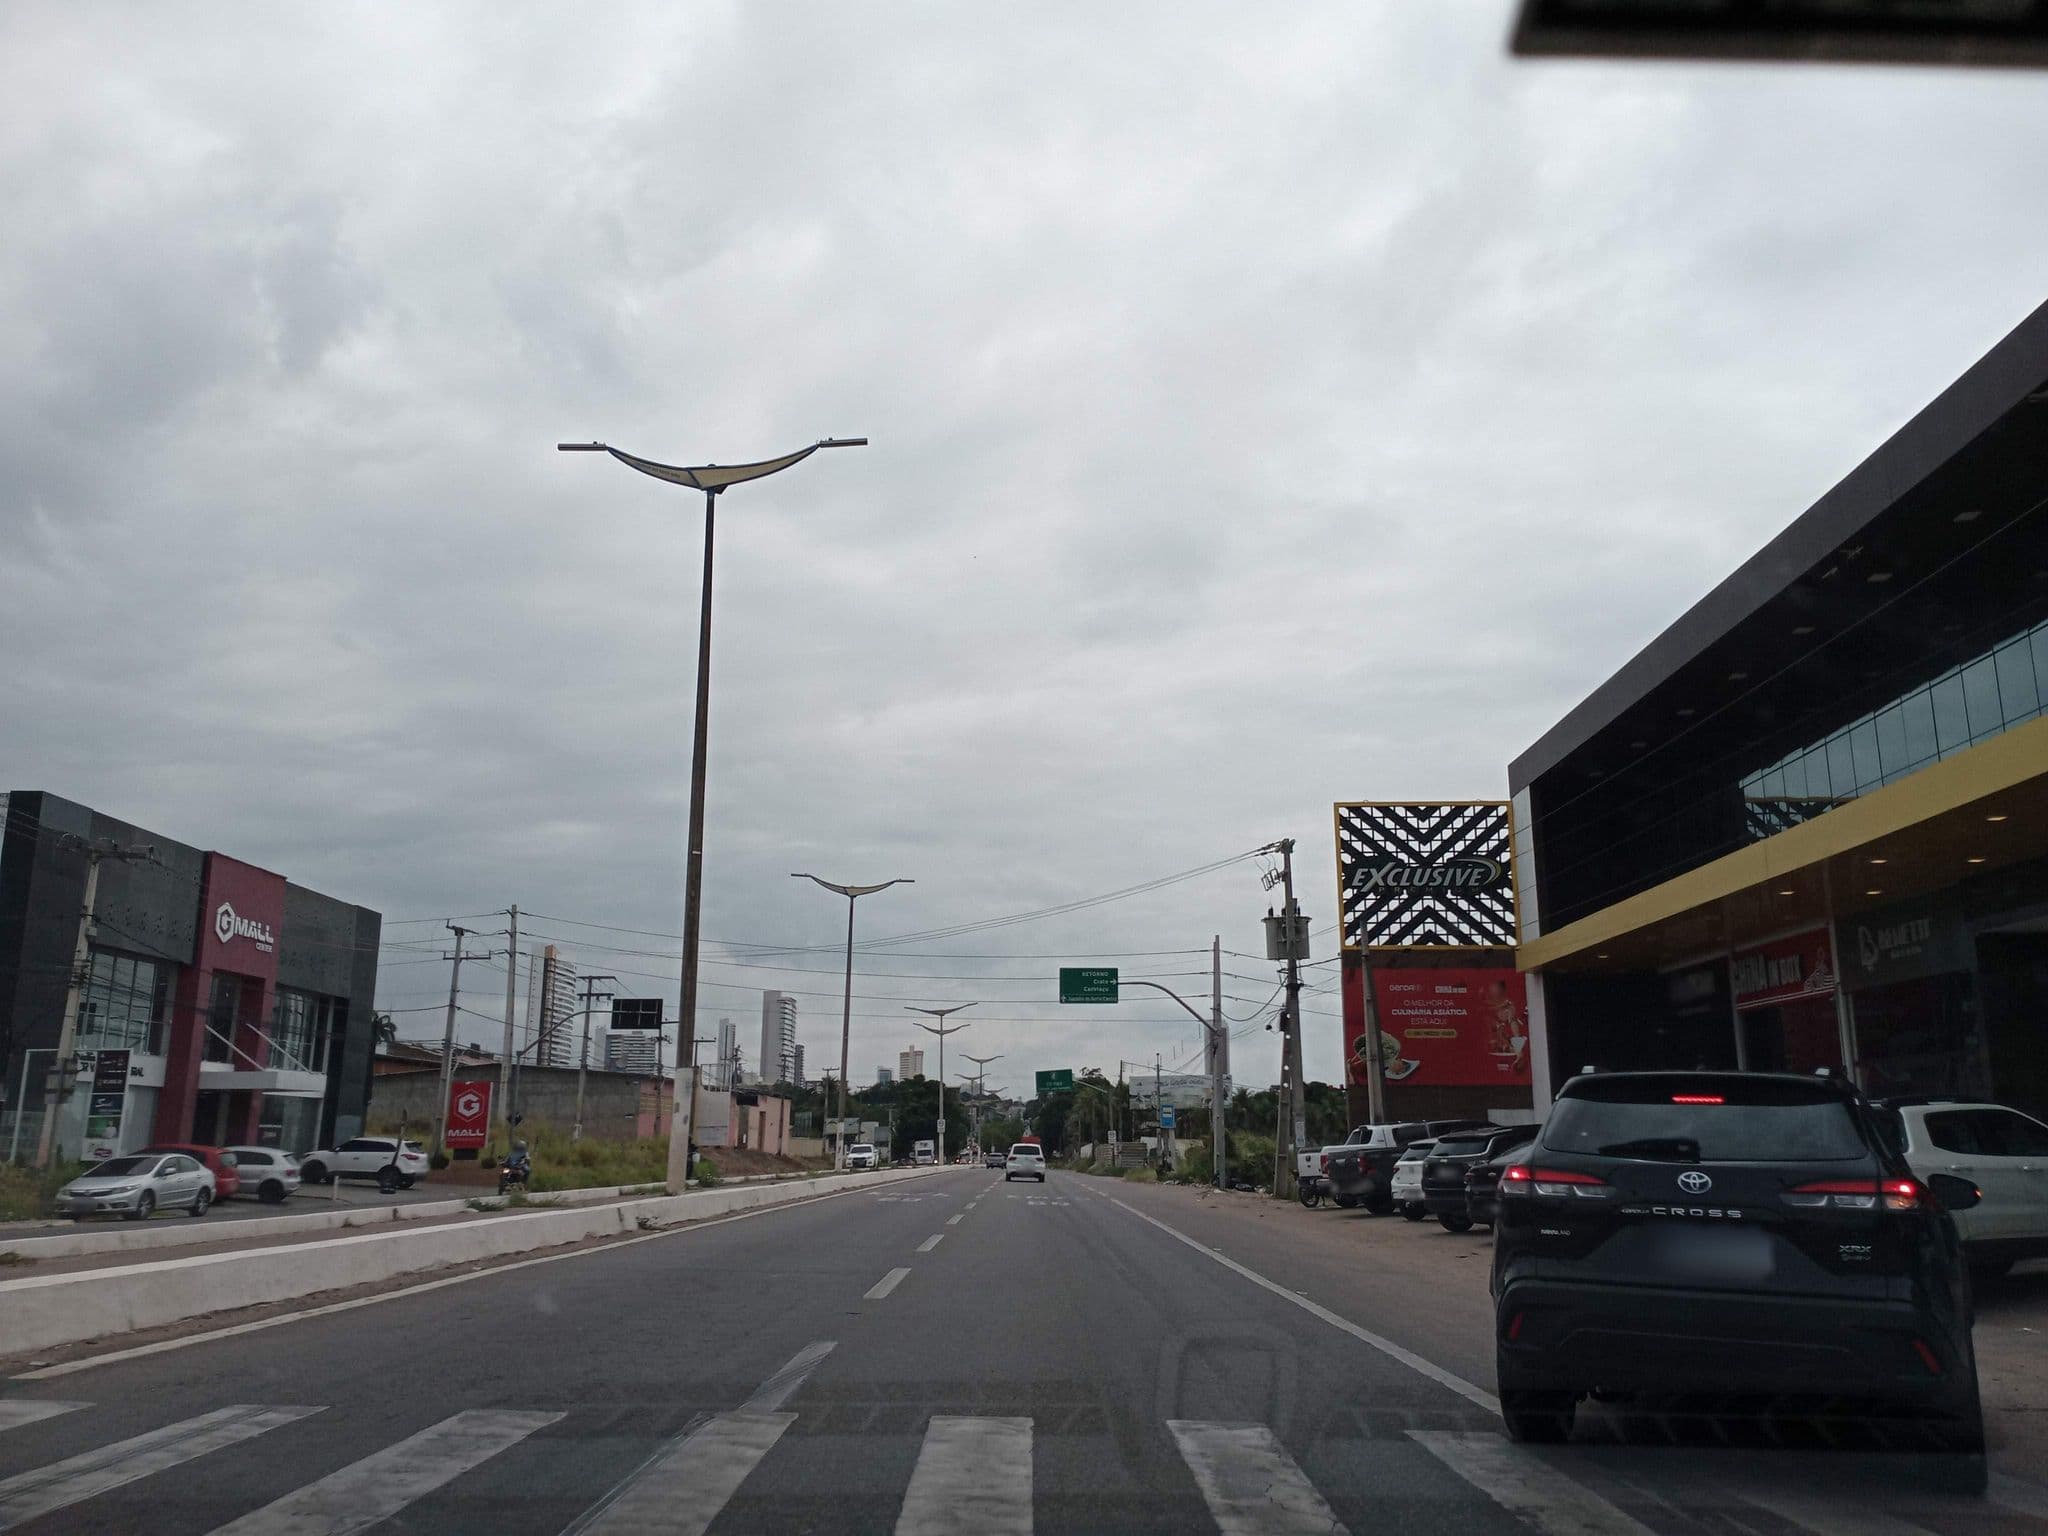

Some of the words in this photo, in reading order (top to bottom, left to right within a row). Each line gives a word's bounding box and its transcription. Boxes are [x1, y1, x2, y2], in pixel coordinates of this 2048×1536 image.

[1352, 862, 1486, 892] EXCLUSIVE
[1410, 999, 1442, 1007] MELHOR
[447, 1129, 485, 1137] MALL
[1652, 1206, 1742, 1218] CROSS
